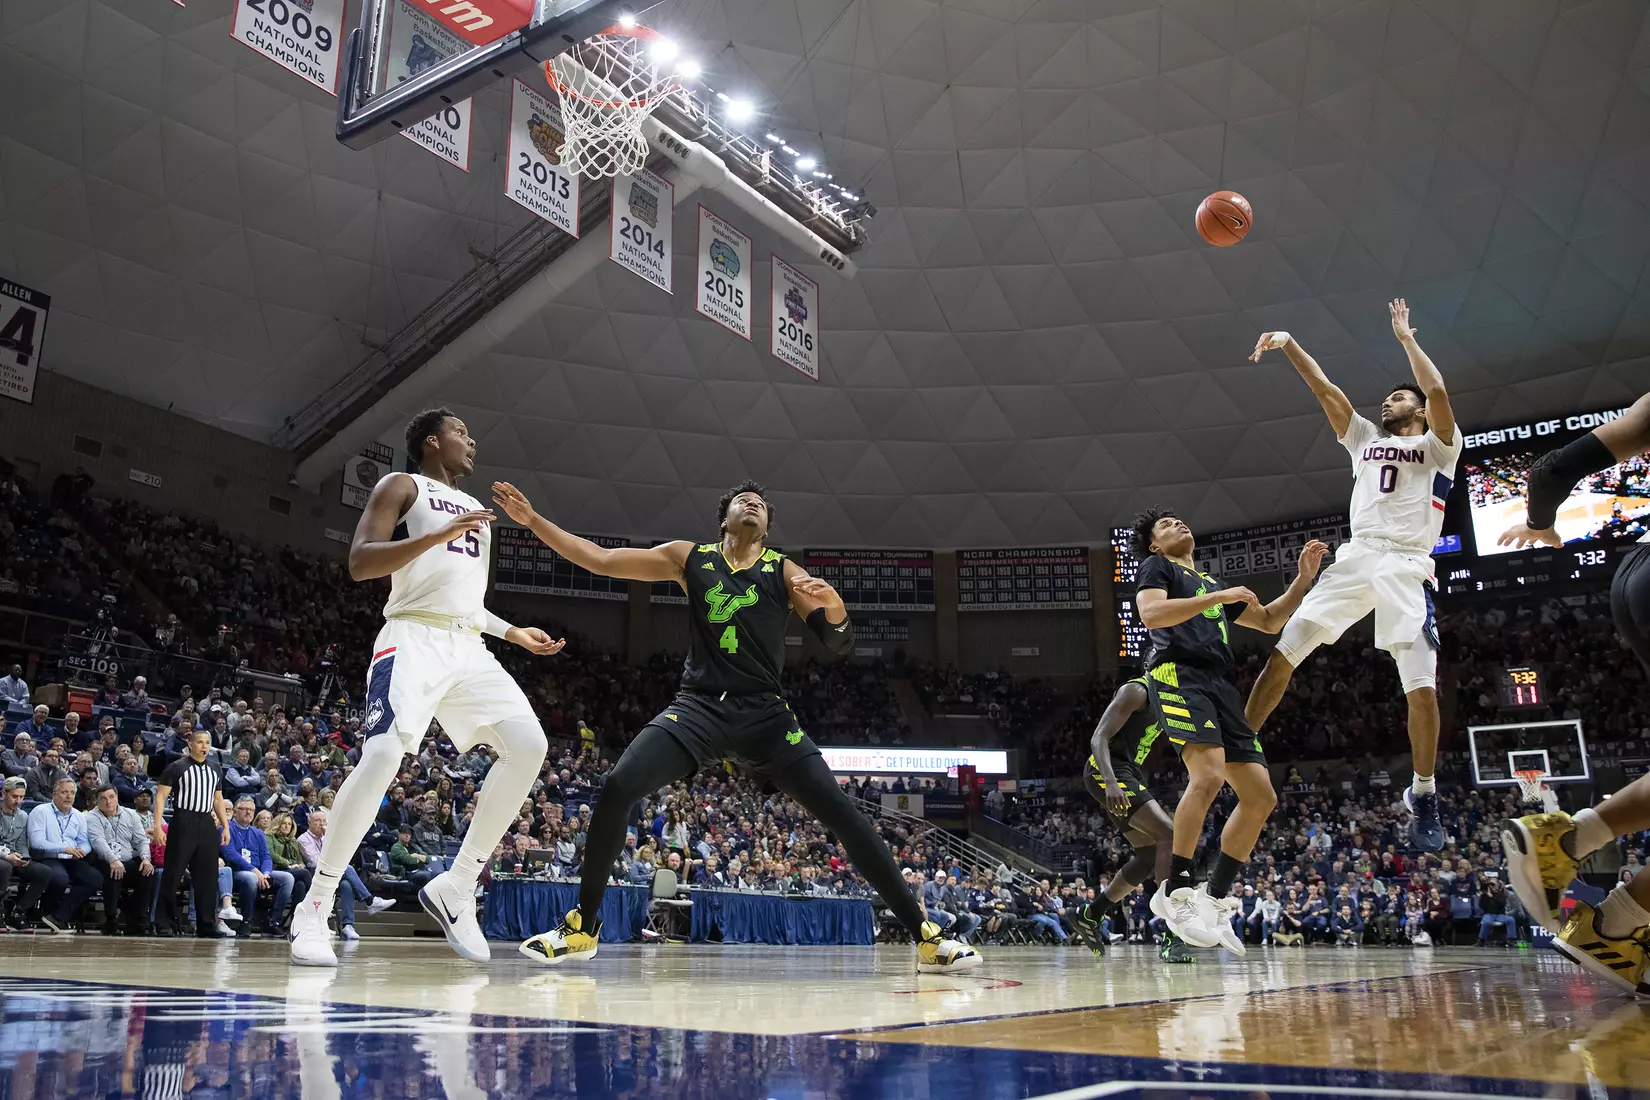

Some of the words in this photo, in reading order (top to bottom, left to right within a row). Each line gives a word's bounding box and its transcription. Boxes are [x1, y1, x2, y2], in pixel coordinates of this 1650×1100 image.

[402, 4, 429, 28] UConn
[254, 17, 321, 66] NATIONAL
[246, 31, 325, 83] CHAMPIONS
[520, 84, 543, 105] UConn
[519, 151, 570, 199] 2013
[519, 178, 568, 214] NATIONAL
[515, 189, 571, 229] CHAMPIONS
[620, 216, 665, 259] 2014
[621, 241, 663, 272] NATIONAL
[618, 252, 666, 286] CHAMPIONS
[2, 282, 32, 301] ALLEN
[704, 270, 744, 309] 2015
[703, 304, 746, 334] CHAMPIONS
[706, 293, 743, 321] NATIONAL
[778, 316, 813, 351] 2016
[776, 348, 814, 375] CHAMPIONS
[779, 338, 812, 363] NATIONAL
[1535, 419, 1561, 436] OF
[1363, 446, 1424, 465] UCONN
[144, 475, 161, 486] 210
[1379, 464, 1399, 494] 0
[500, 529, 519, 538] BIG
[1211, 530, 1243, 541] UCONN
[1247, 523, 1289, 536] HUSKIES
[1293, 520, 1305, 529] OF
[1310, 514, 1343, 526] HONOR
[963, 551, 993, 559] NCAA
[998, 548, 1081, 558] CHAMPIONSHIP
[1225, 556, 1246, 570] 22
[1254, 551, 1275, 567] 25
[1574, 549, 1606, 566] 7:32
[498, 584, 550, 594] CONNECTICUT
[578, 591, 625, 600] BASKETBALL
[1476, 581, 1483, 591] 3
[719, 625, 739, 654] 4
[68, 655, 87, 667] SEC
[90, 657, 119, 675] 109
[1510, 671, 1537, 684] 7:32
[1516, 685, 1537, 704] 11
[839, 755, 871, 768] SOBER
[886, 756, 904, 768] GET
[906, 757, 942, 769] PULLED
[1299, 782, 1317, 792] 114
